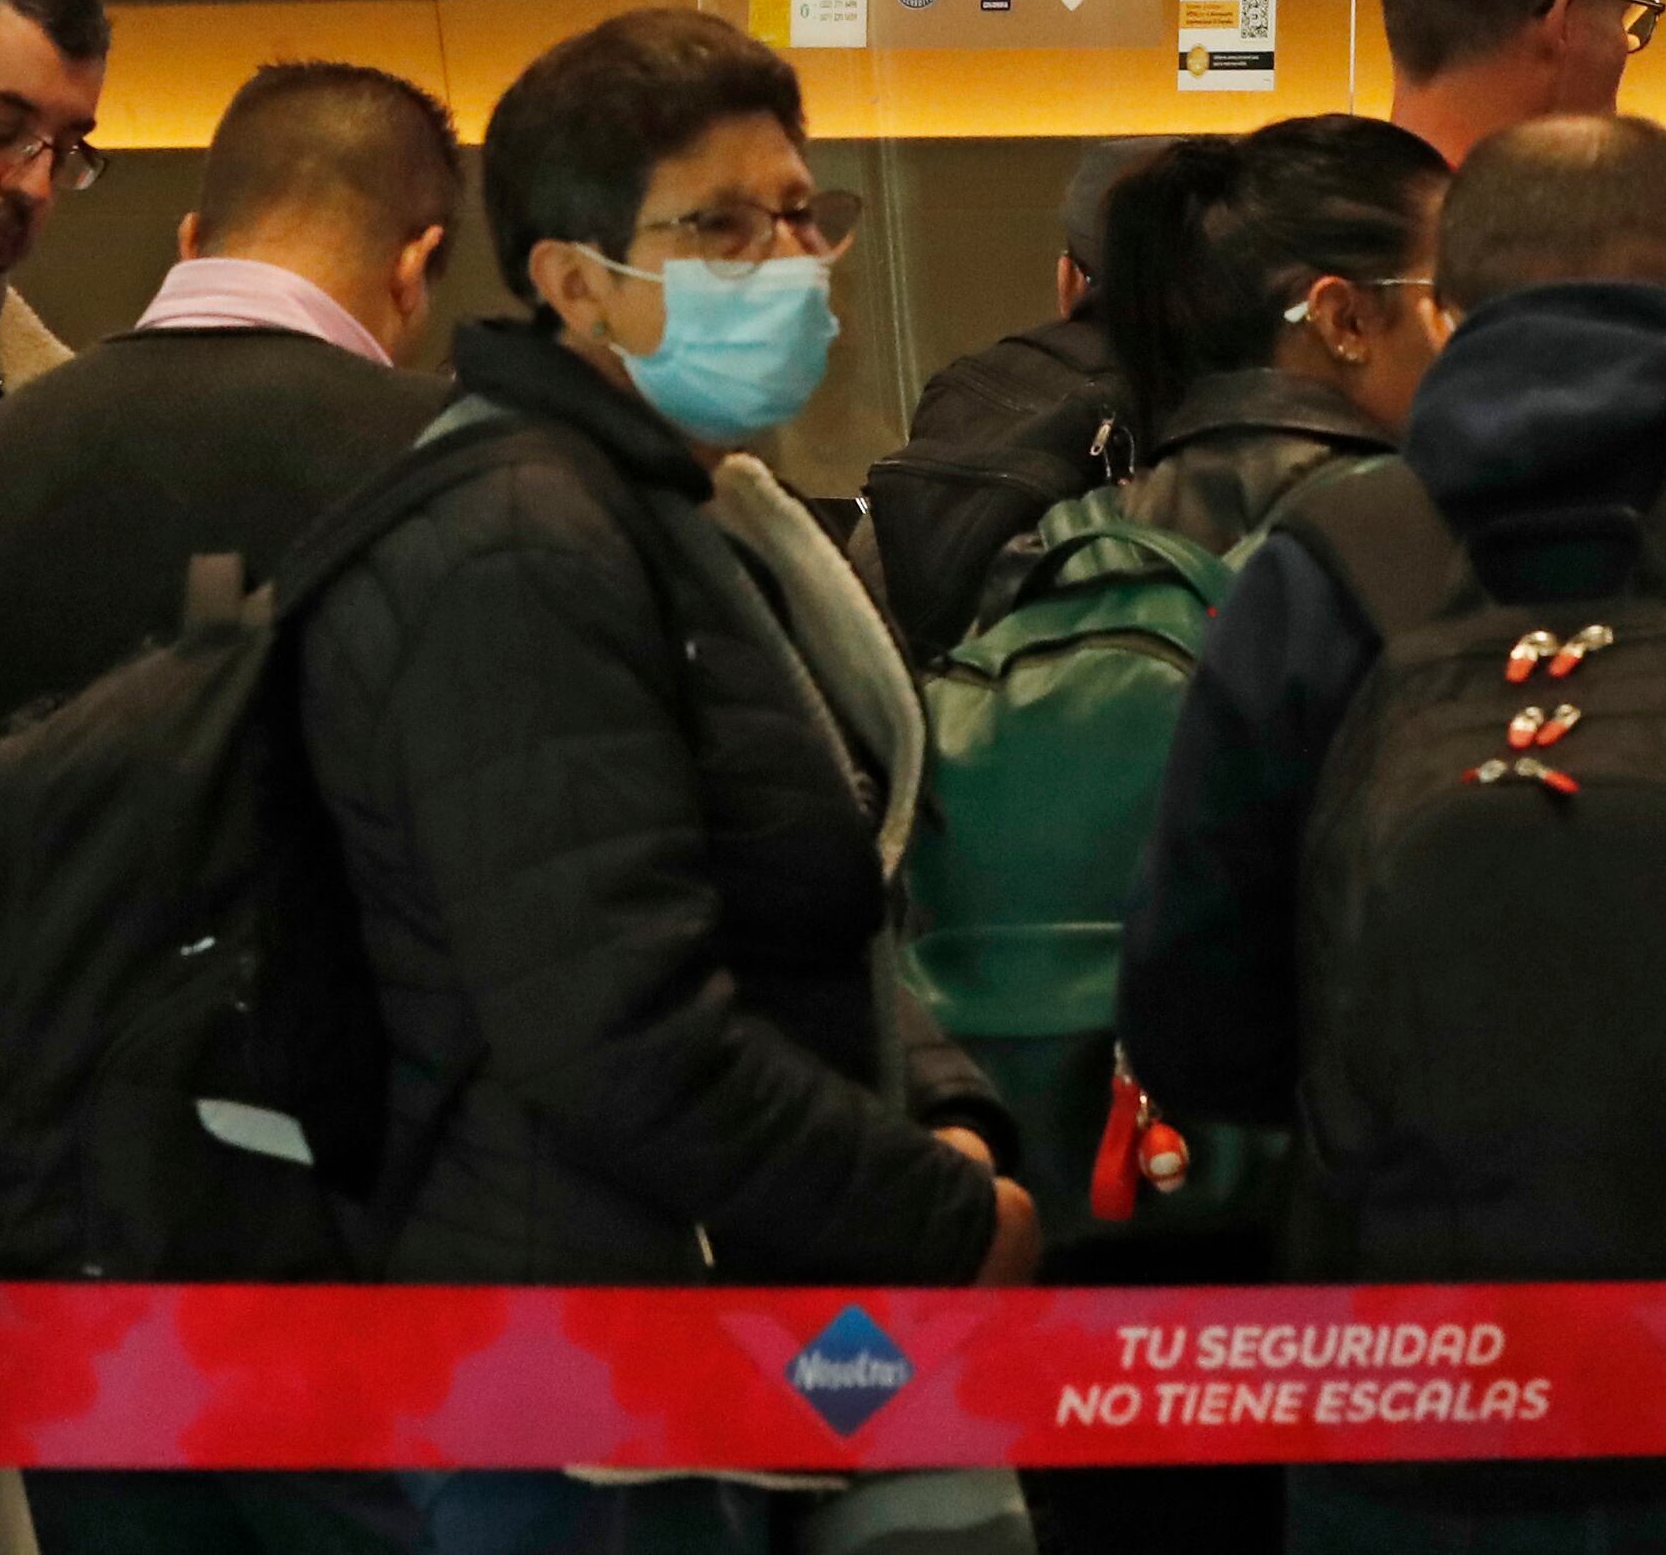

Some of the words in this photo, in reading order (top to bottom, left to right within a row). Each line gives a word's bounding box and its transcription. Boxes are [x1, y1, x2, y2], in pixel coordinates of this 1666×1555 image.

[1117, 1325, 1186, 1369] TU
[1197, 1324, 1504, 1369] SEGURIDAD
[1057, 1385, 1141, 1425] NO
[1157, 1381, 1306, 1424] TIENE
[1315, 1379, 1549, 1423] ESCALAS
